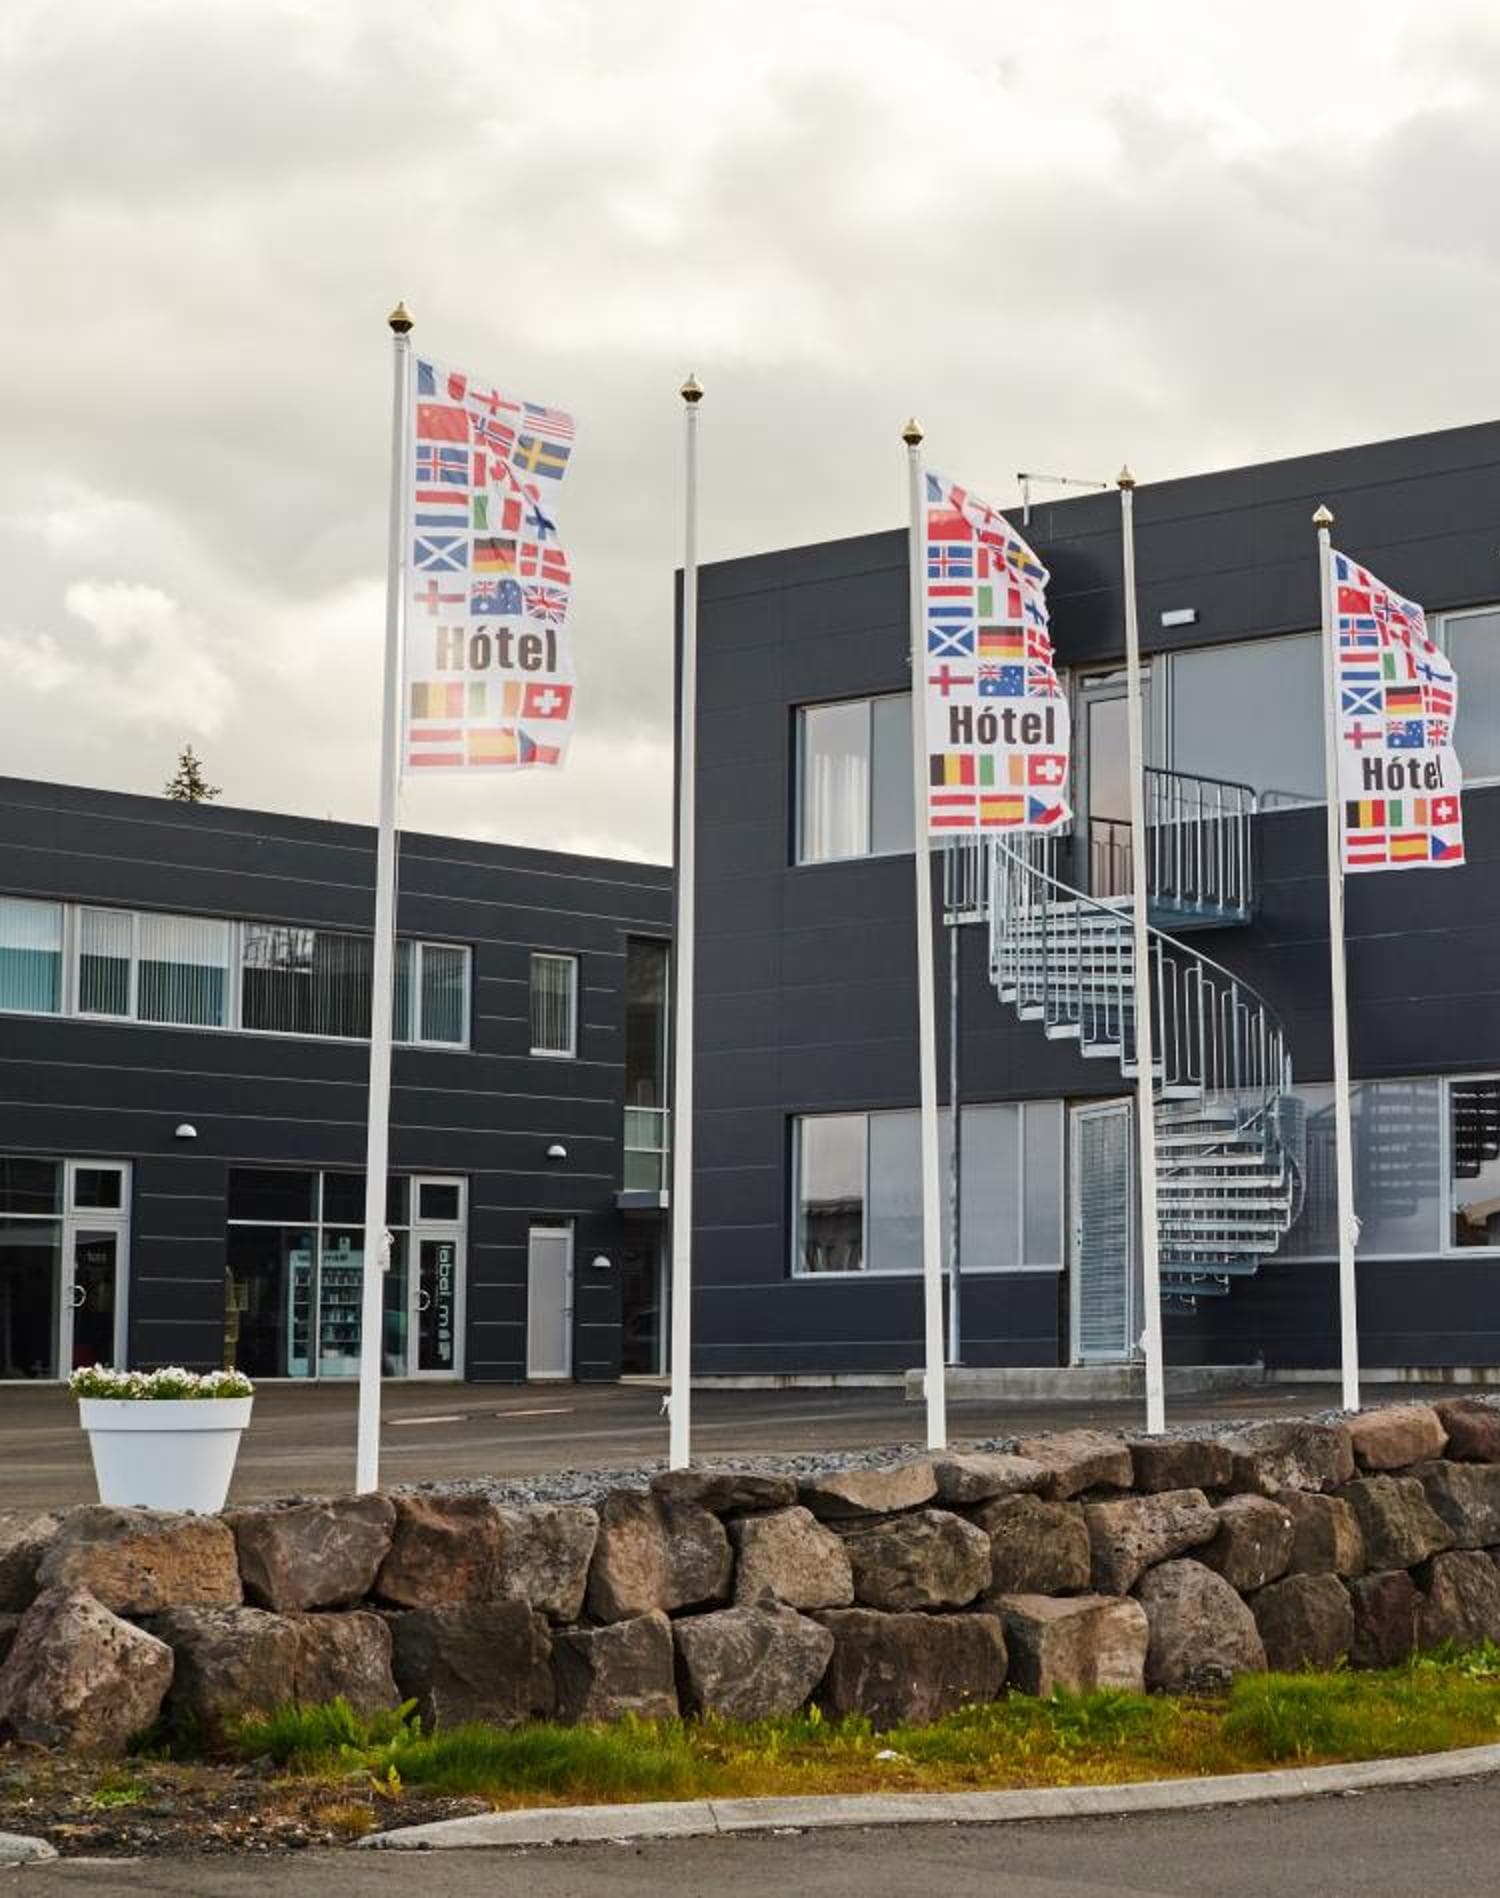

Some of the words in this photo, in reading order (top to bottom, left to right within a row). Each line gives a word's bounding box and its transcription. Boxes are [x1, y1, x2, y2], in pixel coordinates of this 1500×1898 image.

[436, 626, 557, 673] Hótel
[949, 706, 1055, 745] Hótel
[1362, 754, 1444, 791] Hótel
